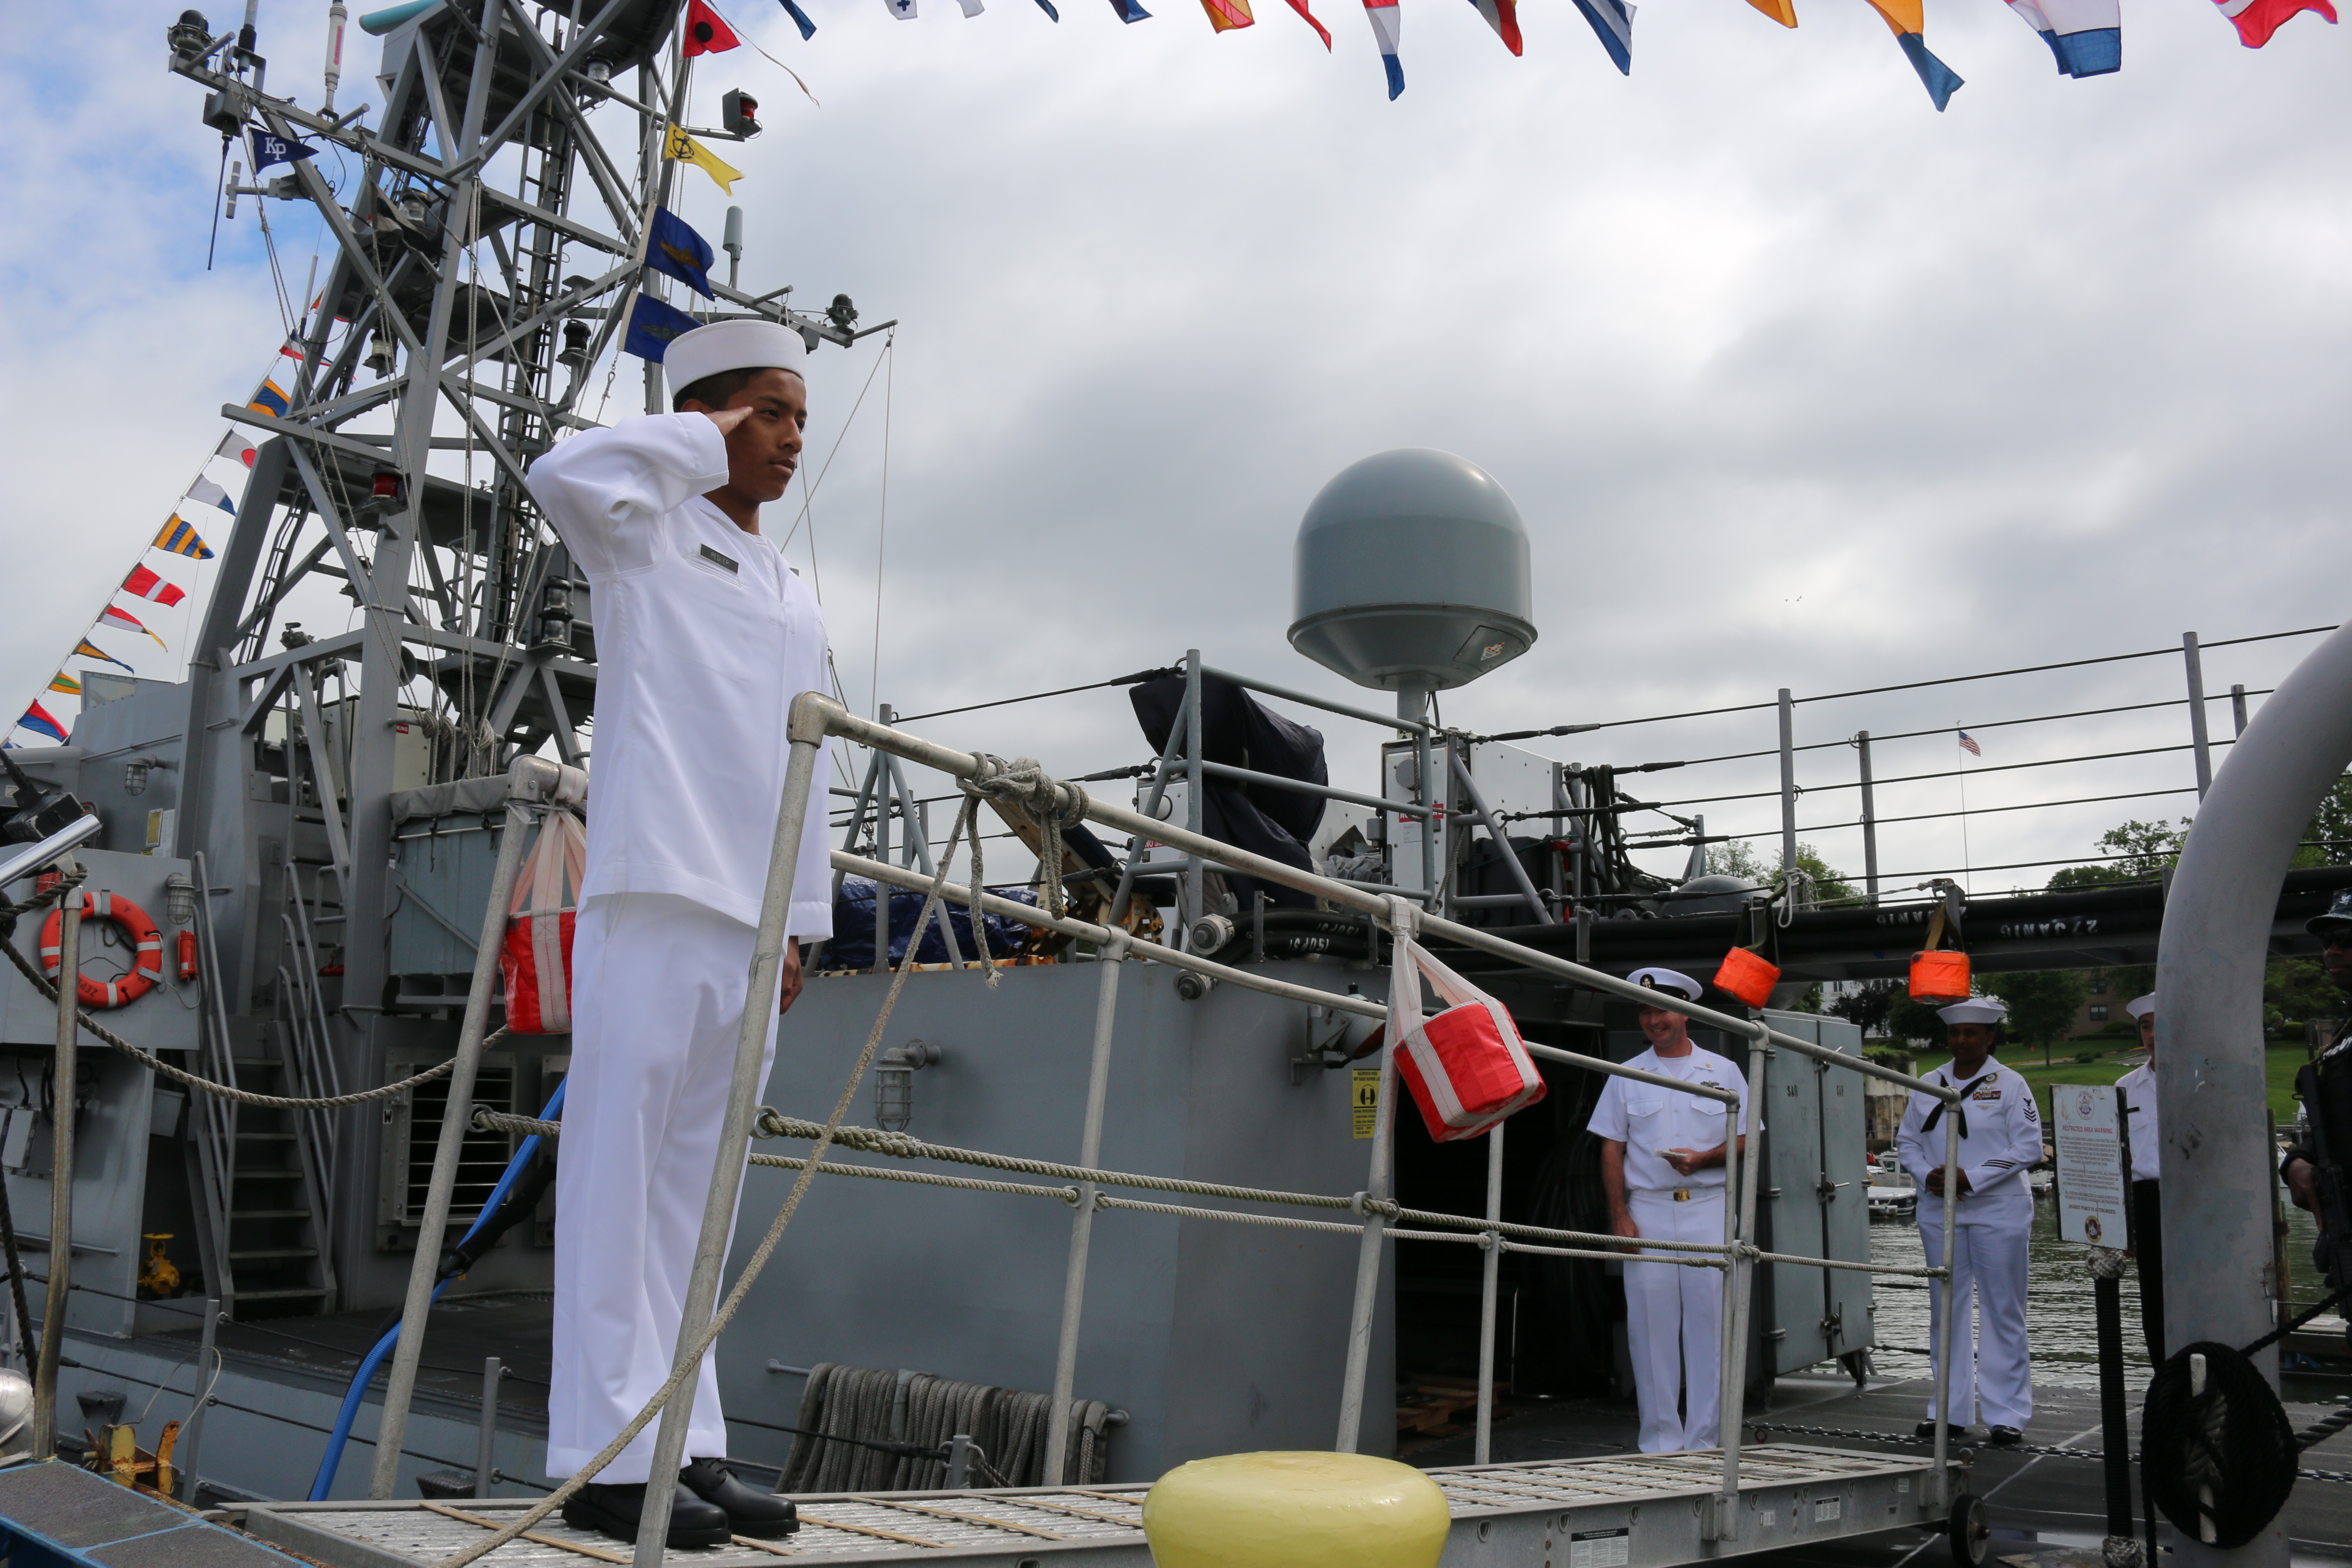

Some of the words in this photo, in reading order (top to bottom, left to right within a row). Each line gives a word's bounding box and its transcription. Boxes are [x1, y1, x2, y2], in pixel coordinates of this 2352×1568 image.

[265, 137, 286, 160] KP
[1787, 1085, 1798, 1097] SAR
[383, 1109, 393, 1124] W
